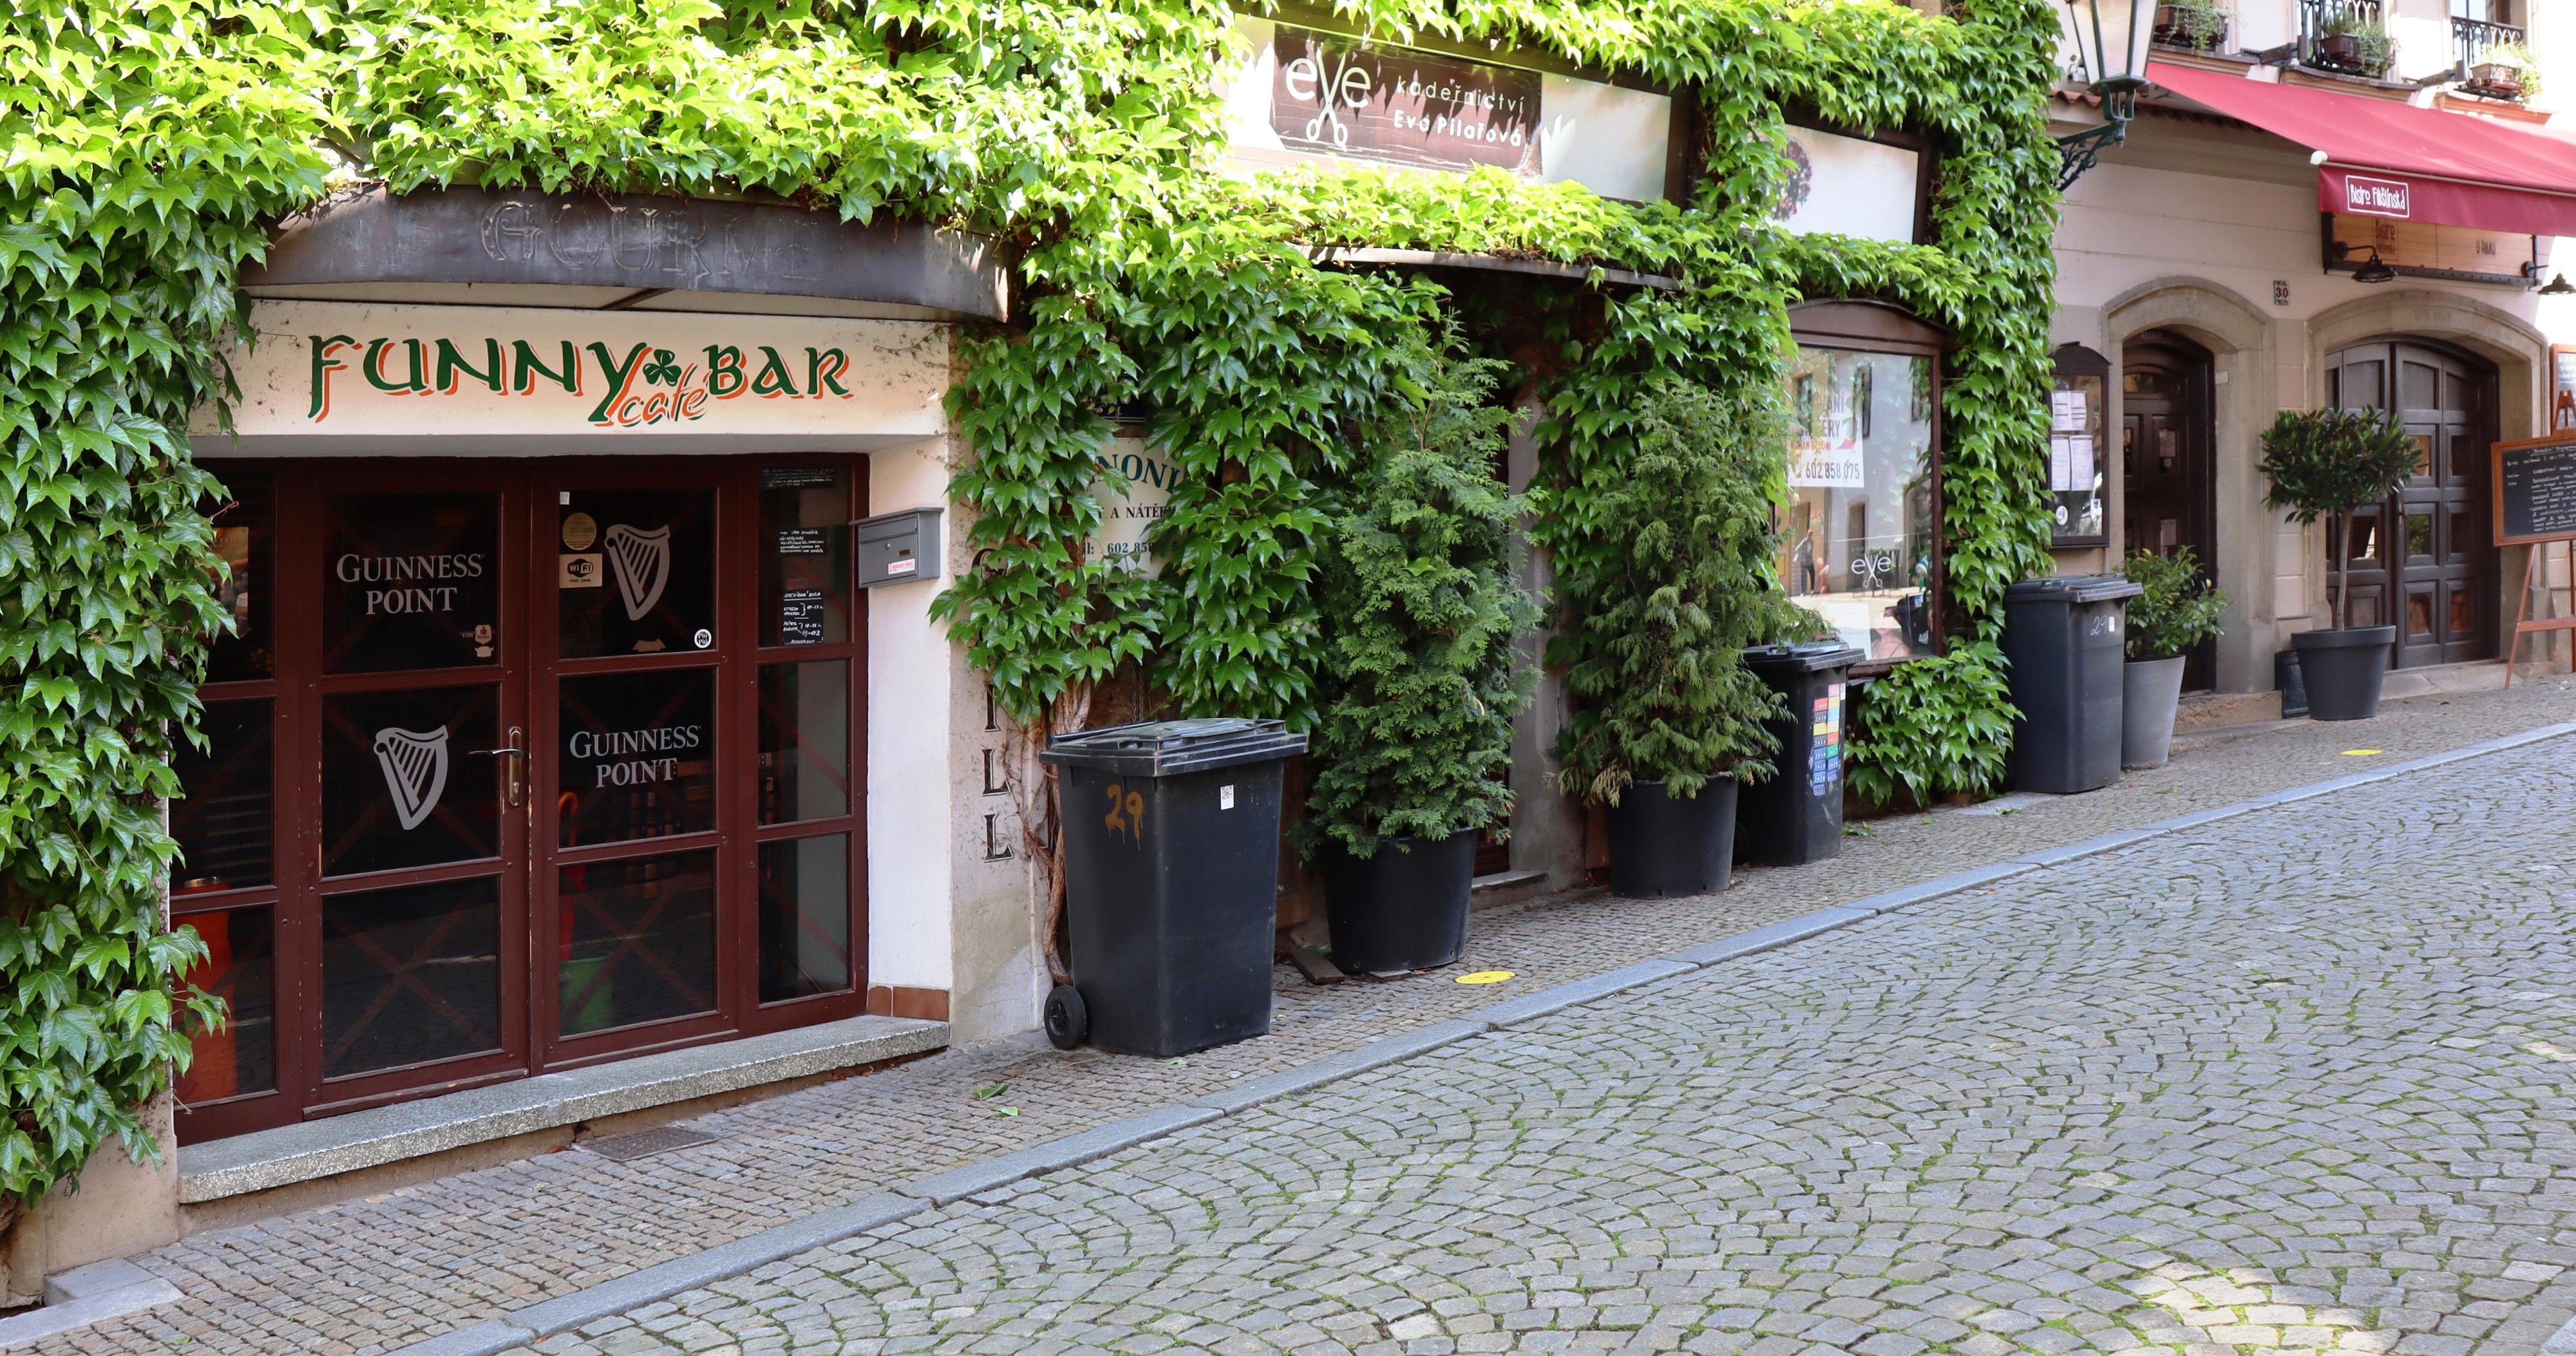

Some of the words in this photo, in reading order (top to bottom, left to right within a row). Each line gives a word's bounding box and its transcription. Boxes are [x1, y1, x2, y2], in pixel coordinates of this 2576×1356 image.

[1285, 42, 1370, 147] eve
[1396, 75, 1526, 113] kadeřnictví
[1394, 109, 1430, 133] Eva
[1436, 115, 1522, 147] Pilařová
[2350, 184, 2371, 205] Bistro
[2276, 287, 2289, 299] 30
[308, 335, 653, 427] FUNNY
[702, 344, 855, 400] BAR
[1806, 462, 1823, 479] 602
[1824, 462, 1841, 480] 858
[1844, 460, 1860, 480] 075
[1110, 507, 1120, 518] A
[1126, 502, 1177, 518] NÁTĚR
[1107, 542, 1129, 554] 602
[1852, 553, 1891, 588] eve
[366, 587, 458, 616] POINT
[2090, 615, 2107, 636] 29
[596, 757, 677, 788] POINT
[1105, 784, 1144, 849] 29
